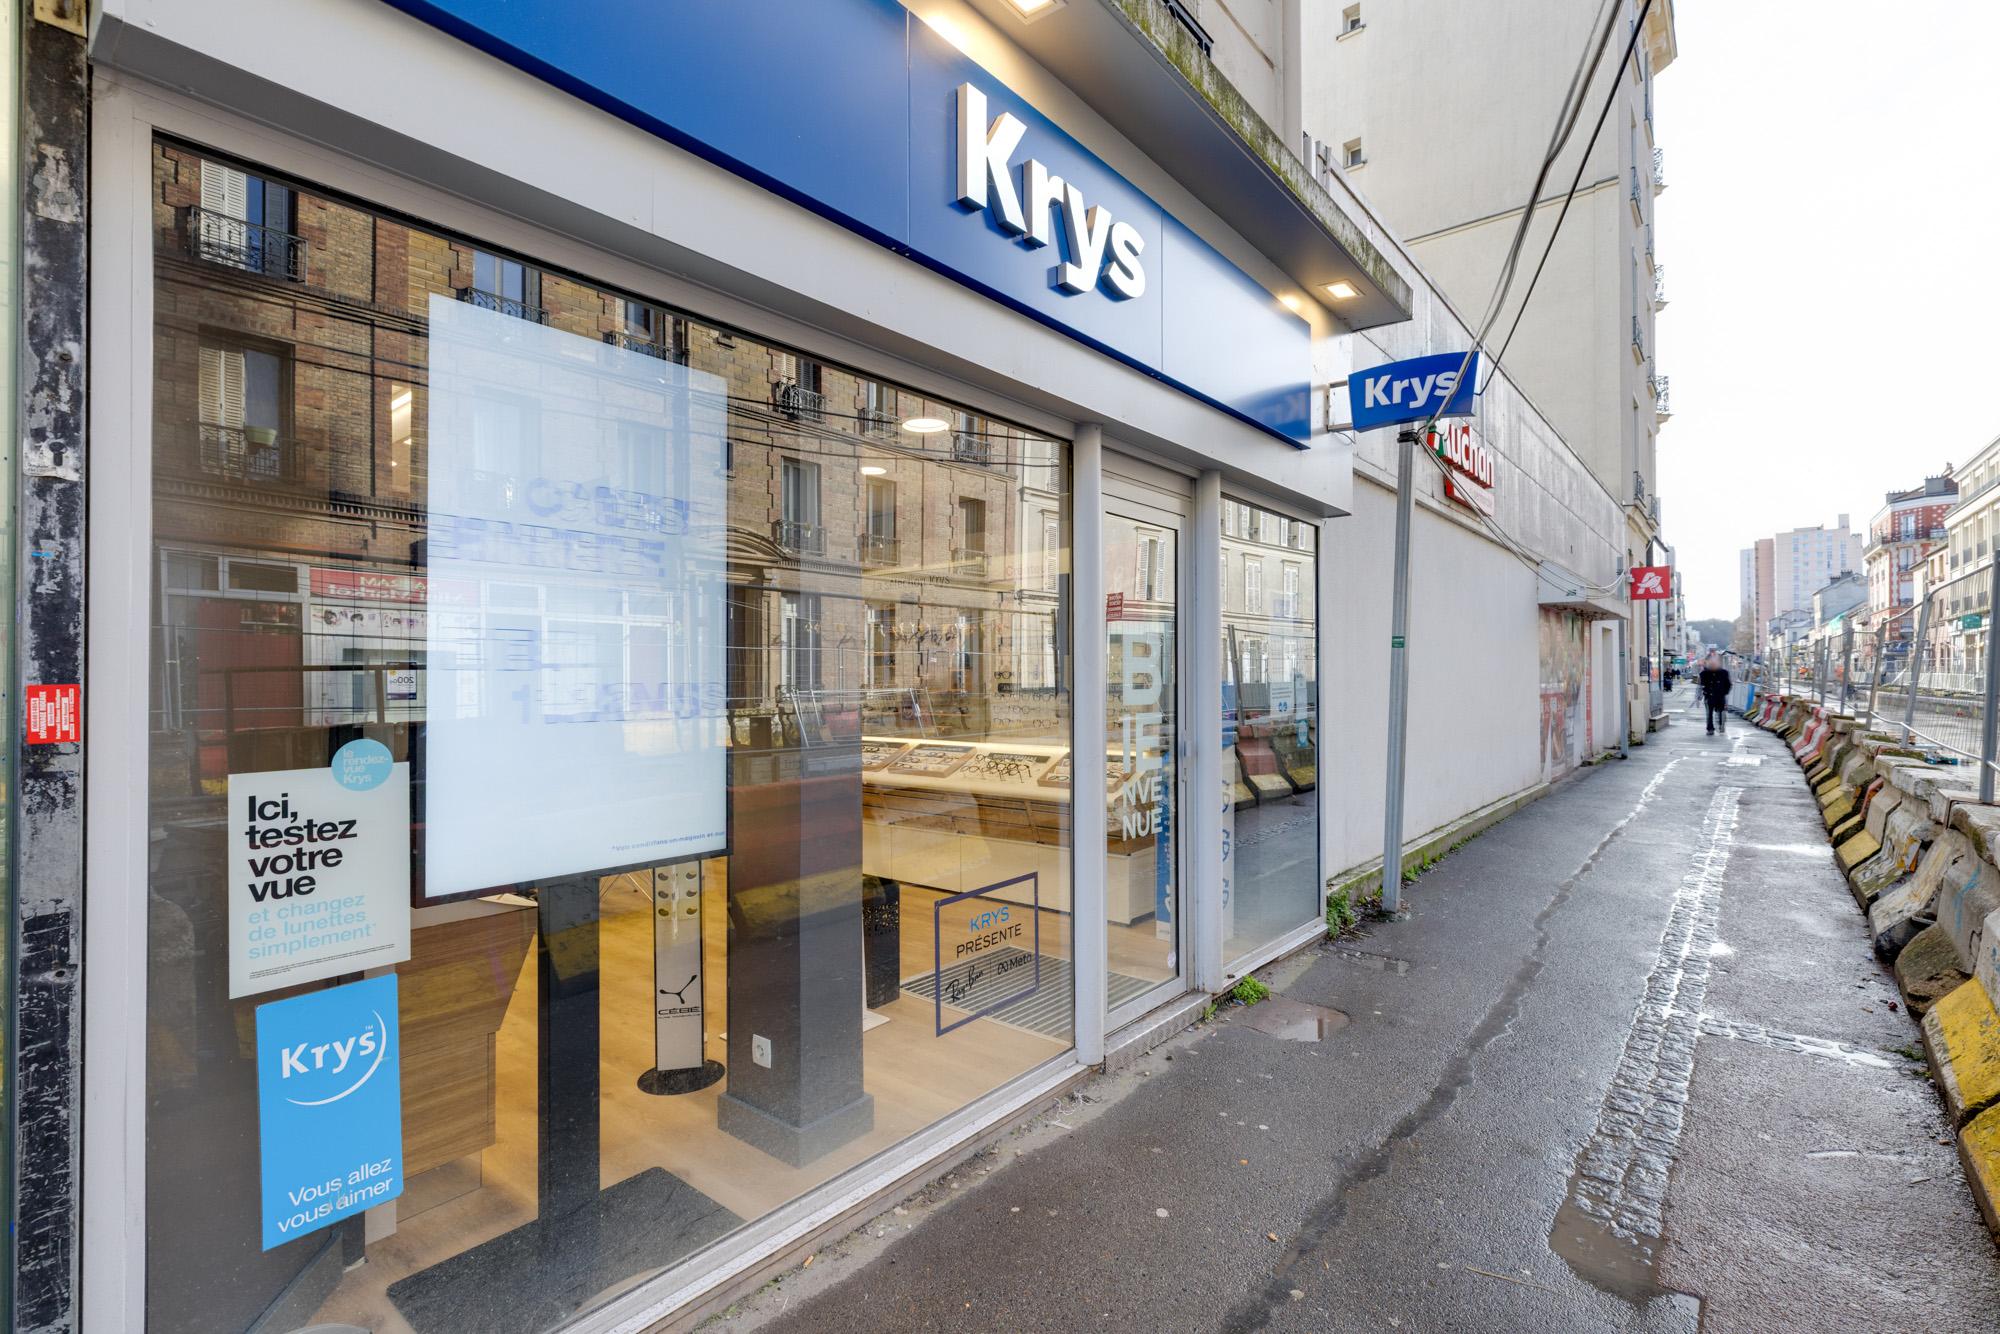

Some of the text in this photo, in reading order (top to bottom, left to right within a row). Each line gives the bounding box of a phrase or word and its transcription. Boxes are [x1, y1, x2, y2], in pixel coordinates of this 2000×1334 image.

[957, 81, 1146, 298] Krys
[1364, 371, 1459, 409] Krys
[247, 792, 298, 824] Ici,
[244, 818, 358, 850] testez
[247, 847, 343, 878] votre
[247, 875, 317, 903] vue
[248, 894, 366, 925] et changez
[969, 906, 1010, 933] KRYS
[248, 911, 367, 943] de lunettes
[955, 923, 1023, 959] PRÉSENTE
[281, 1031, 376, 1079] Krys
[288, 1158, 393, 1207] Vous allez
[277, 1178, 393, 1233] vous aimer
